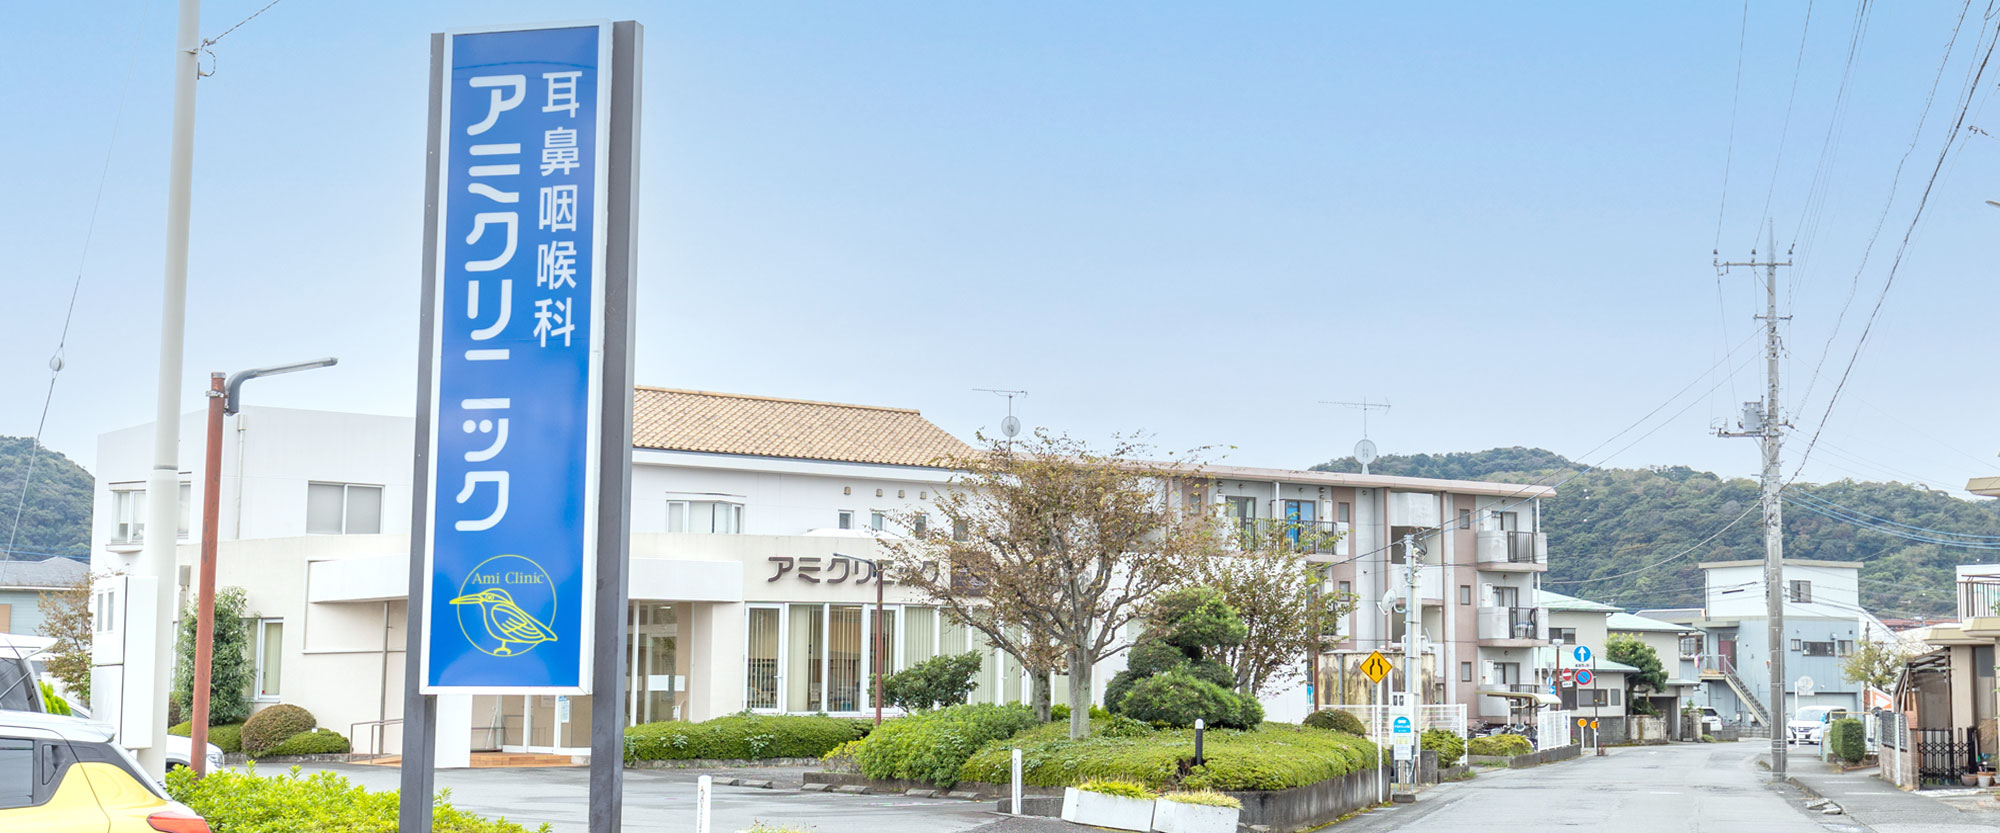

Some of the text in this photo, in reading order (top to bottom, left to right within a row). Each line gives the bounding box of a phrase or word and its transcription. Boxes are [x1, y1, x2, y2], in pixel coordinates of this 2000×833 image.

[533, 71, 582, 348] 耳鼻咽喉科
[455, 74, 526, 532] アミクリニック
[472, 571, 544, 584] Ami Clinic
[768, 556, 940, 585] アミクリニク
